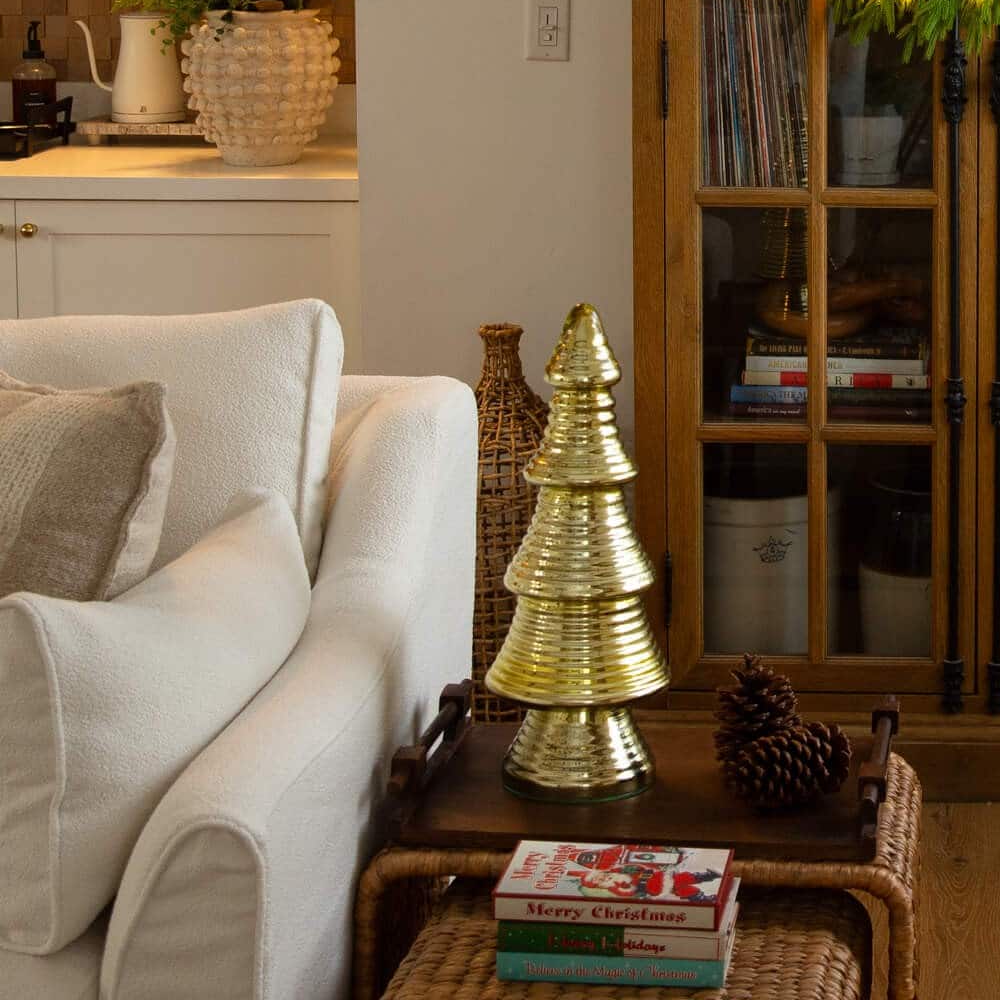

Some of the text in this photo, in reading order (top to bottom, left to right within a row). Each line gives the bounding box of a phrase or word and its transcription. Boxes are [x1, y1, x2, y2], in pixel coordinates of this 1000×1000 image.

[511, 851, 546, 880] Merry
[526, 902, 687, 923] Merry Christmas
